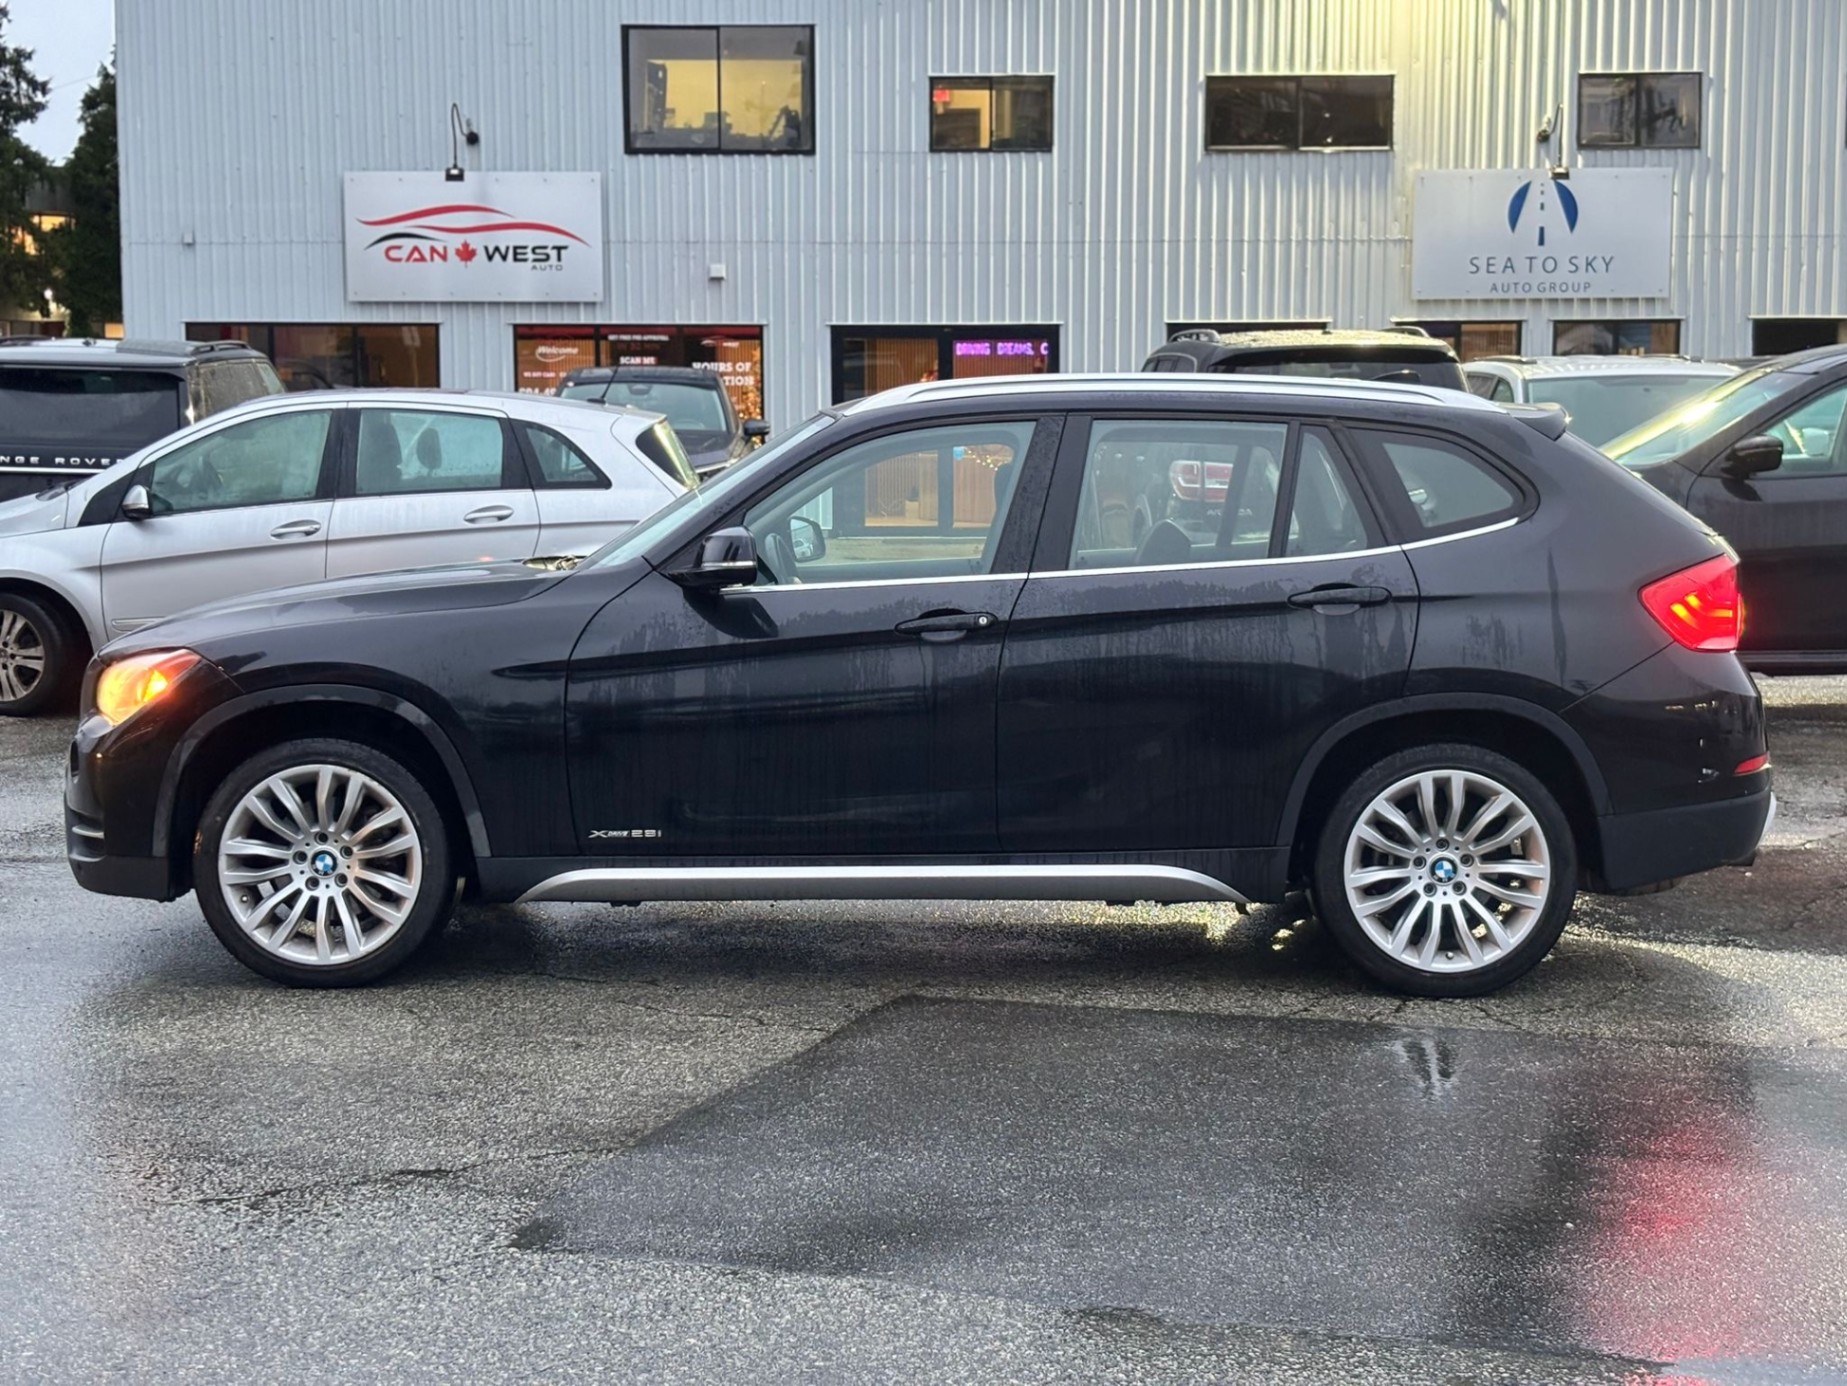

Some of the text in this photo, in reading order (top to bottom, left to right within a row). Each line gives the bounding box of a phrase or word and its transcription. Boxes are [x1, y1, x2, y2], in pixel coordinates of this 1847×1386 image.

[384, 245, 569, 263] CAN WEST
[530, 264, 563, 272] AUTO
[1469, 256, 1614, 274] SEA TO SKY
[1490, 282, 1591, 294] AUTO GROUP
[537, 346, 578, 354] Welcome
[619, 356, 641, 365] SCAN
[736, 362, 752, 372] OF
